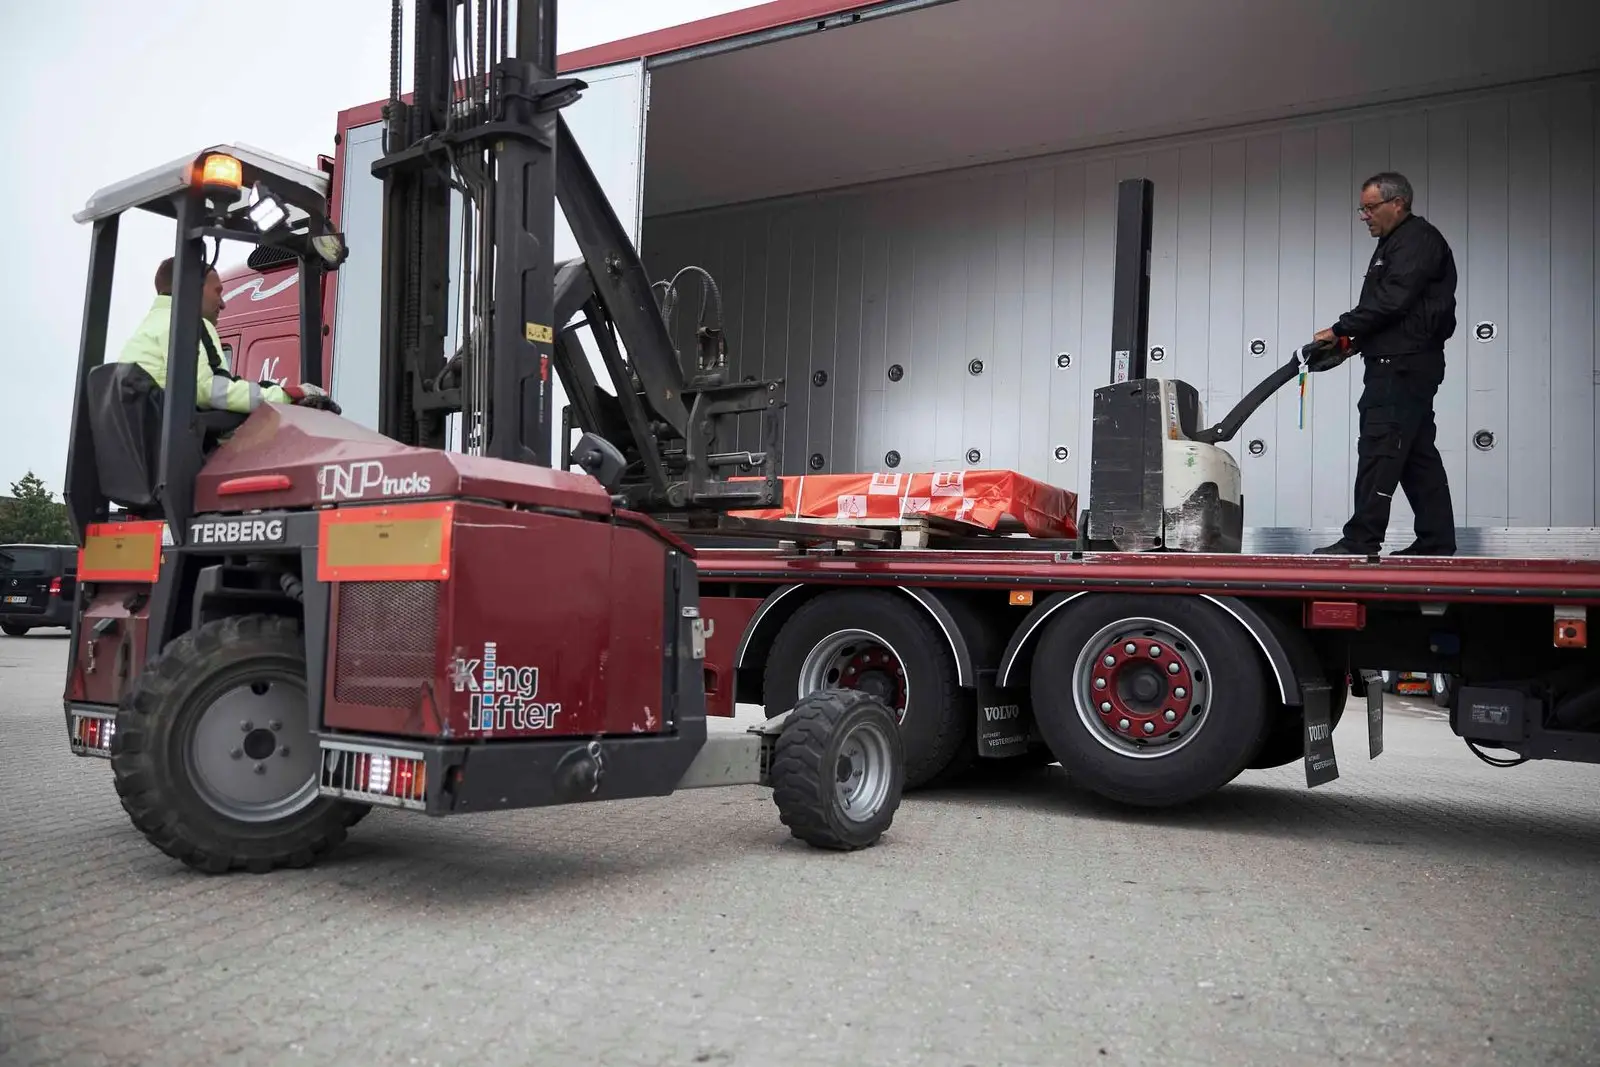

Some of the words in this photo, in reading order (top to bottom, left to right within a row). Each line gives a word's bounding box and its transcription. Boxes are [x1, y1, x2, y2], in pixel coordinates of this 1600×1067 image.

[382, 472, 431, 495] trucks
[191, 520, 283, 543] TERBERG
[984, 705, 1019, 721] VOLVO
[1308, 723, 1329, 741] VOLVO
